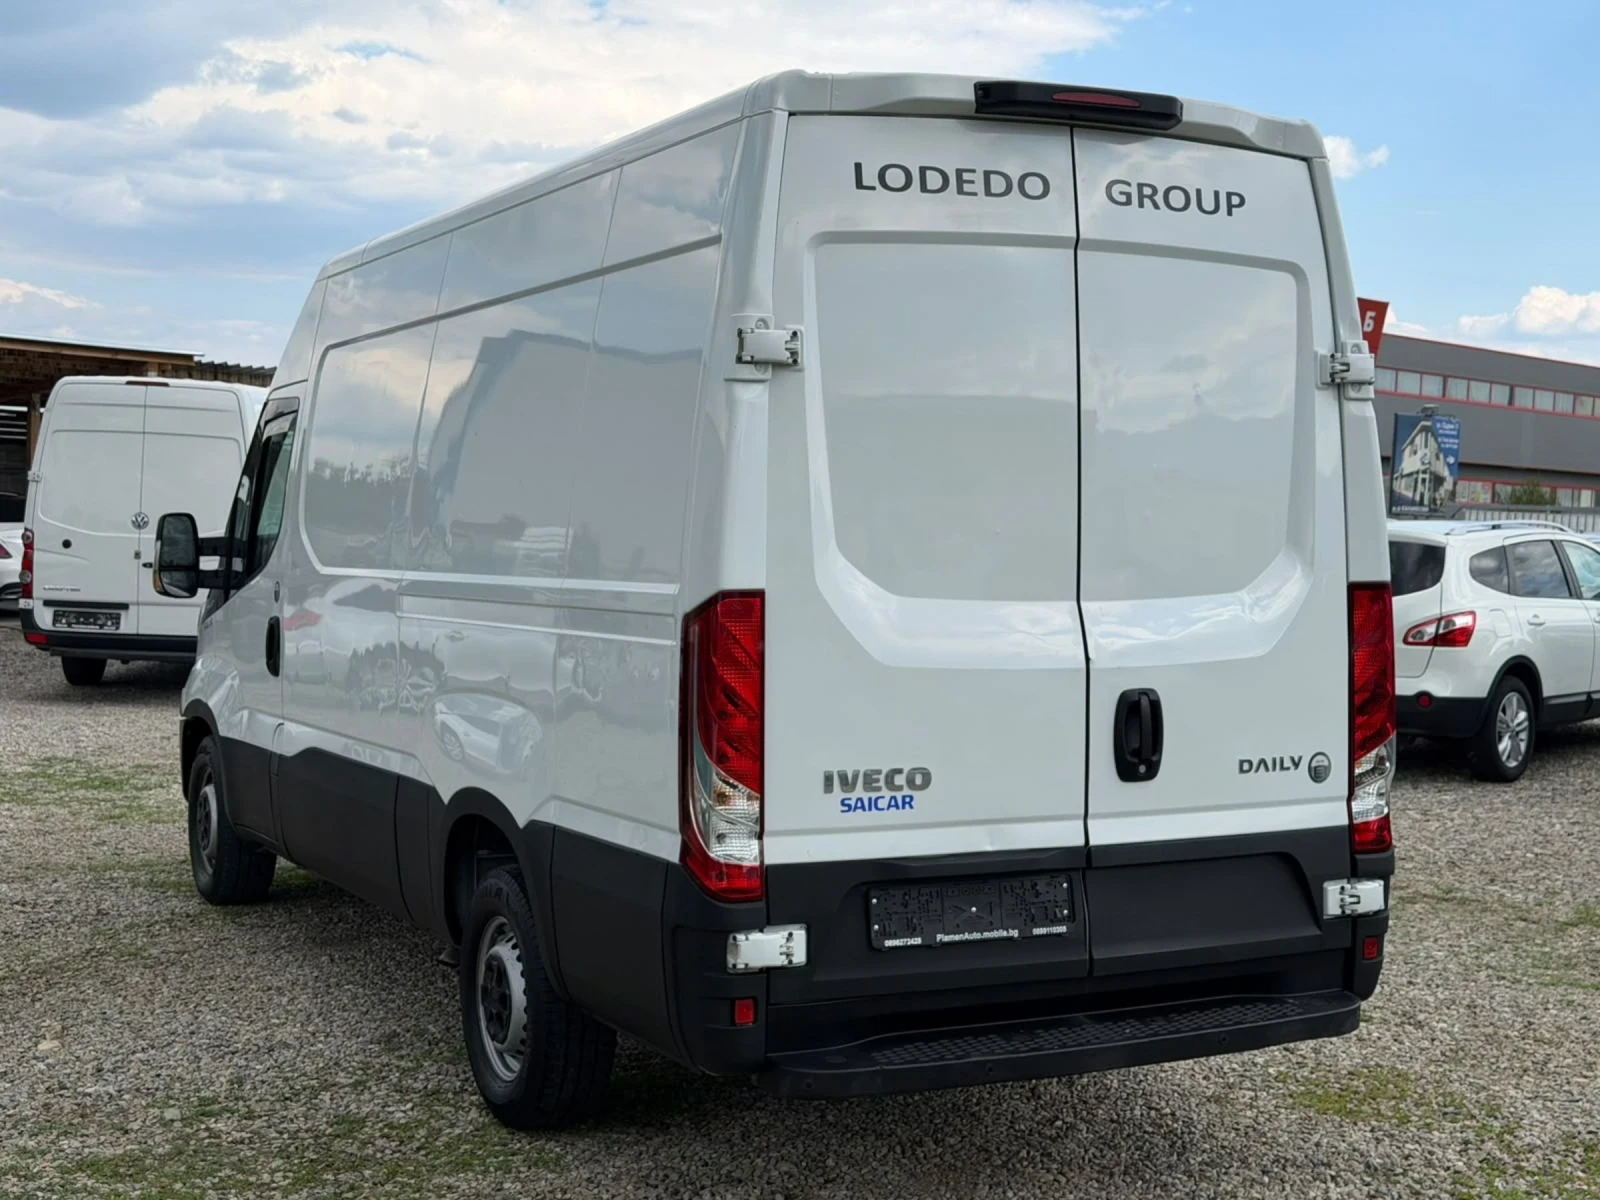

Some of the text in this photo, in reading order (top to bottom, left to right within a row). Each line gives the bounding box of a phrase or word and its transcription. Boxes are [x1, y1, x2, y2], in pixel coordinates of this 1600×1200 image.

[853, 161, 1247, 218] LODEDO GROUP
[1238, 755, 1303, 774] DAILY
[823, 766, 933, 794] IVECO
[840, 794, 915, 813] SAICAR
[936, 928, 1018, 942] PlamenAuto.mobile.bg
